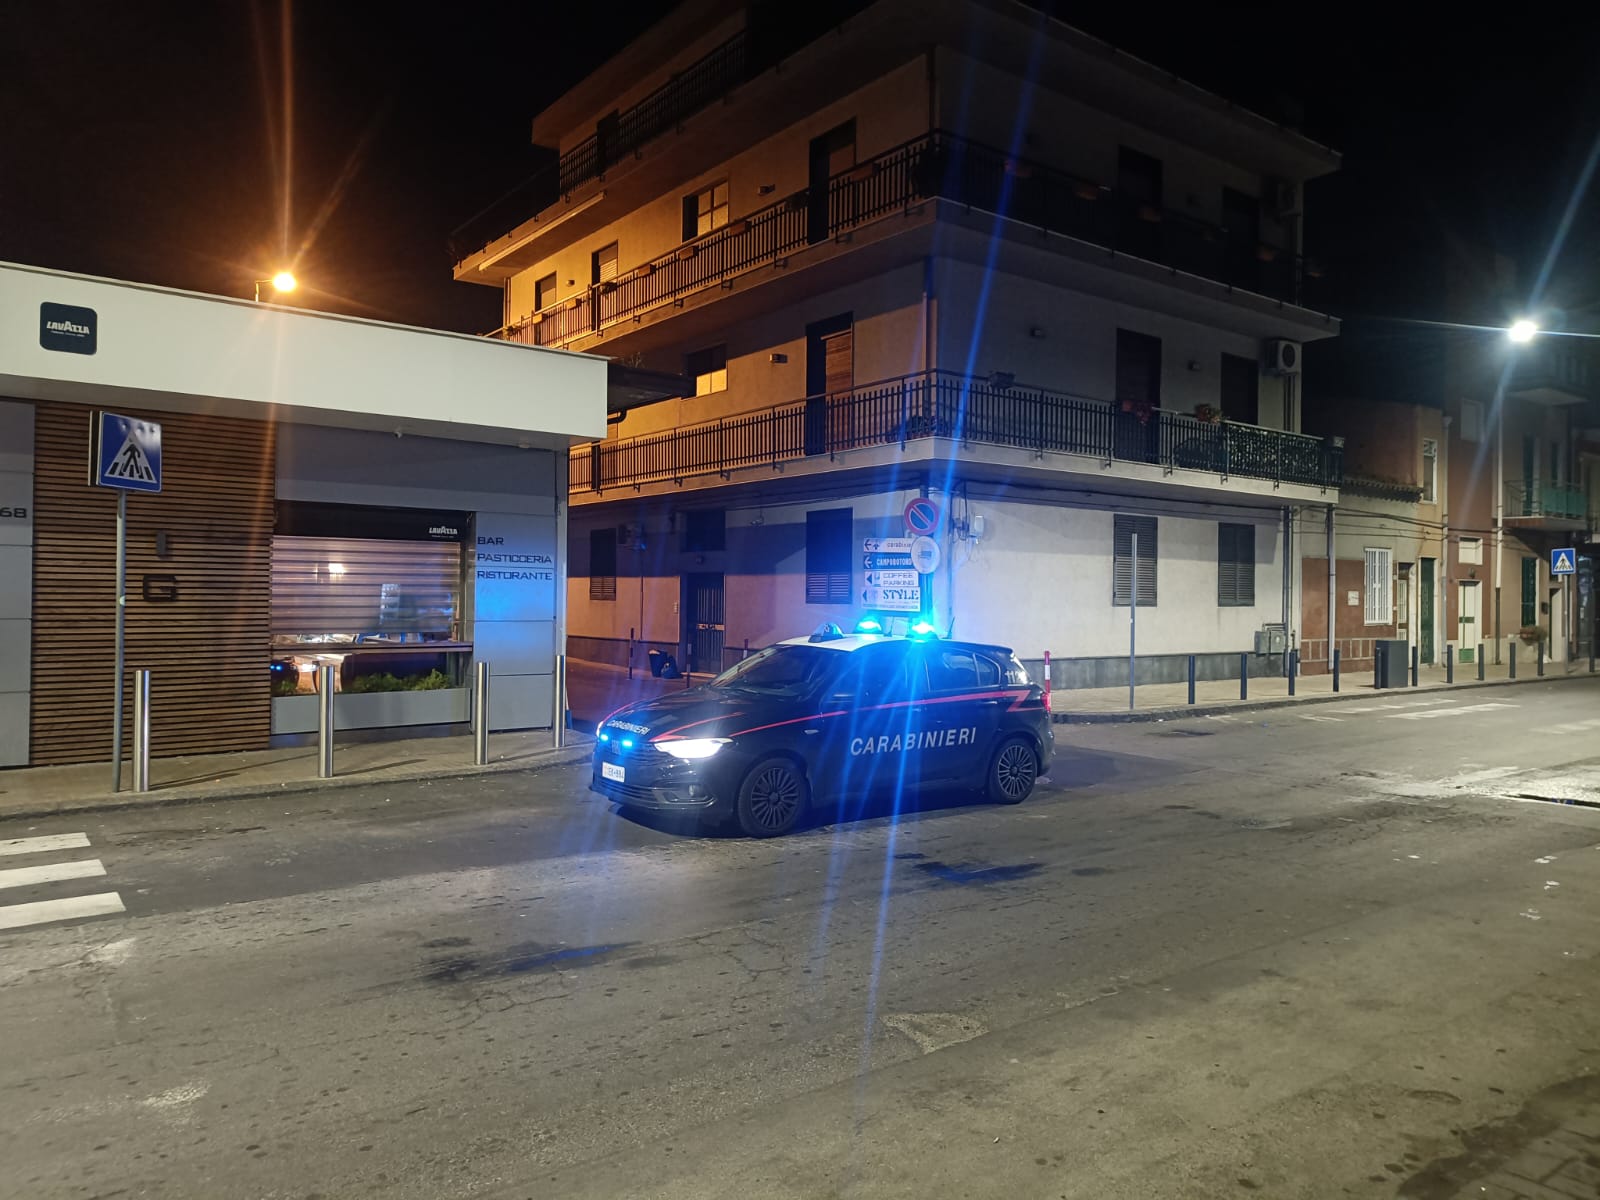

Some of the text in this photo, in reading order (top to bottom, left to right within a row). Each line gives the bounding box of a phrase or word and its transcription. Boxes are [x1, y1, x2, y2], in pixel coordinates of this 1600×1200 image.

[46, 320, 90, 335] LAVAZZA
[428, 525, 458, 535] LAVAZZA
[477, 536, 504, 545] BAR
[477, 553, 552, 564] PASTICCERIA
[477, 570, 553, 581] RISTORANTE
[883, 588, 919, 600] STYLE
[850, 727, 977, 756] CARABINIERI
